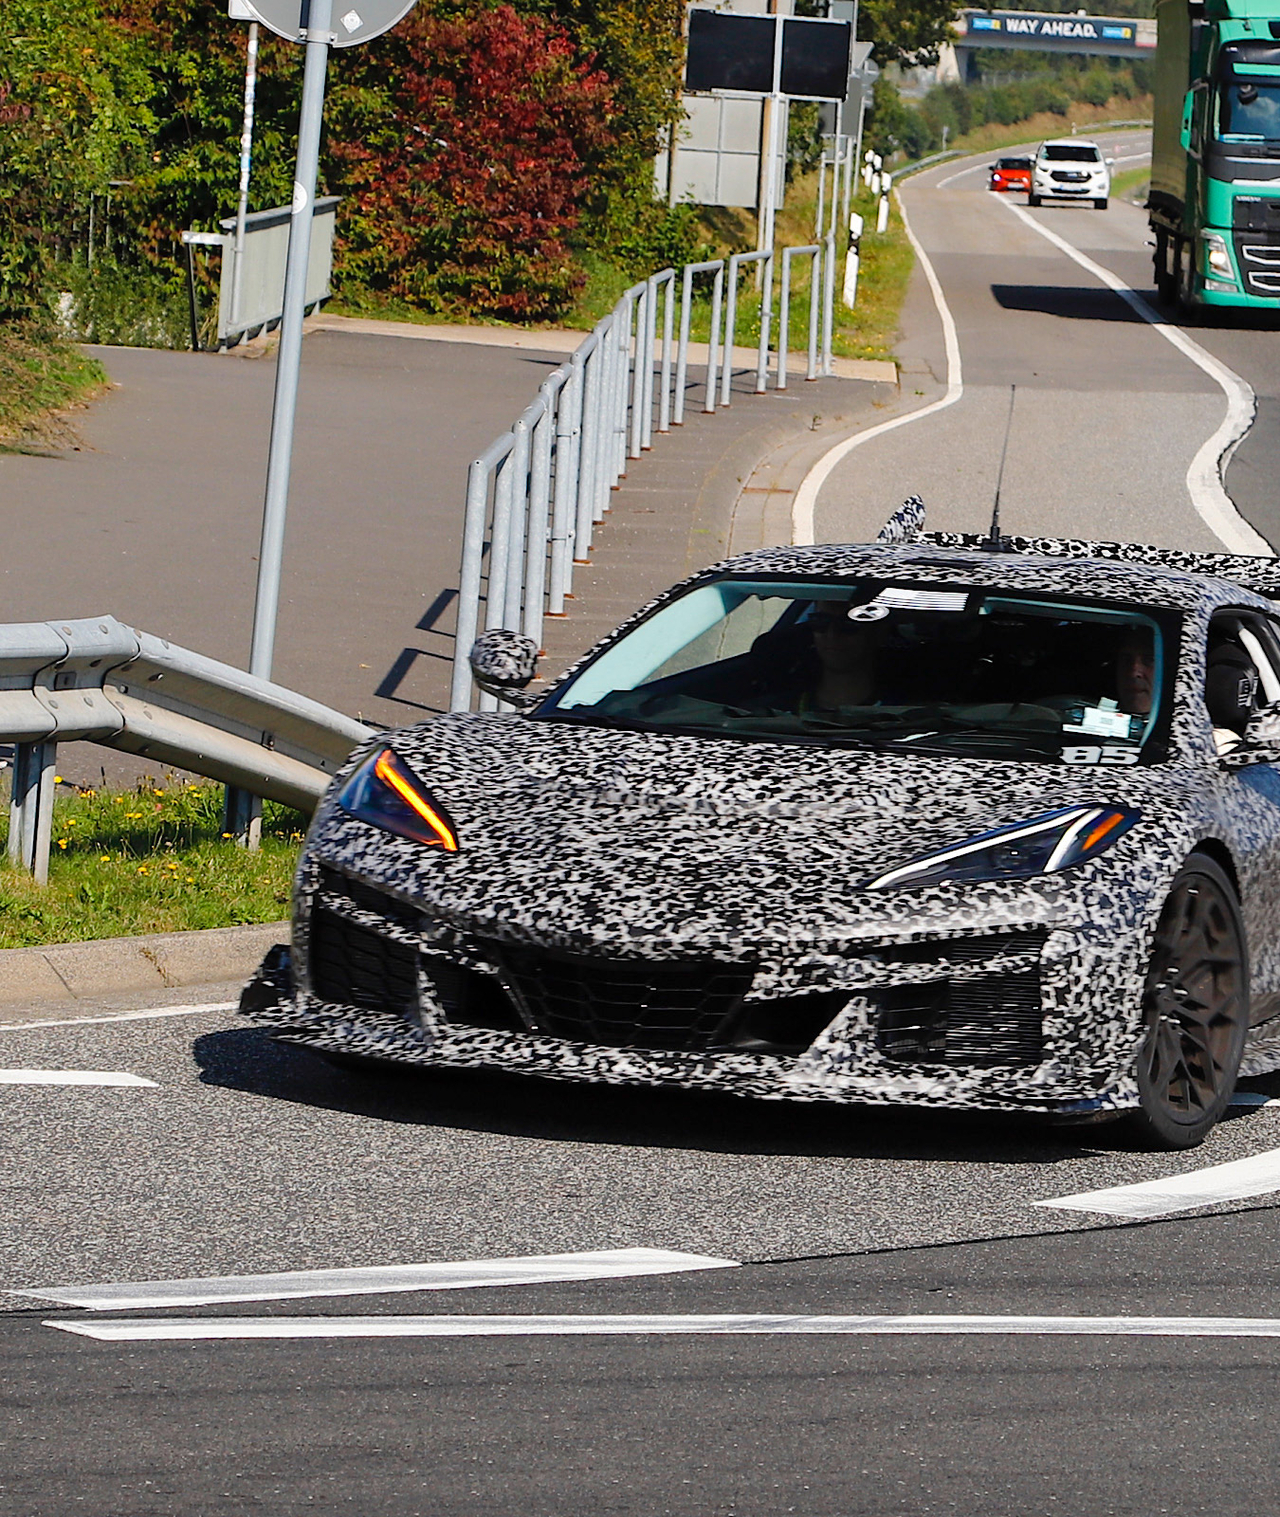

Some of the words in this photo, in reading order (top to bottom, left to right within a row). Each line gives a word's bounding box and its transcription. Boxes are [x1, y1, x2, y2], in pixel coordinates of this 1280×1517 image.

[1006, 18, 1039, 34] WAY
[1040, 21, 1098, 38] AHEAD.
[1059, 746, 1142, 764] 85
